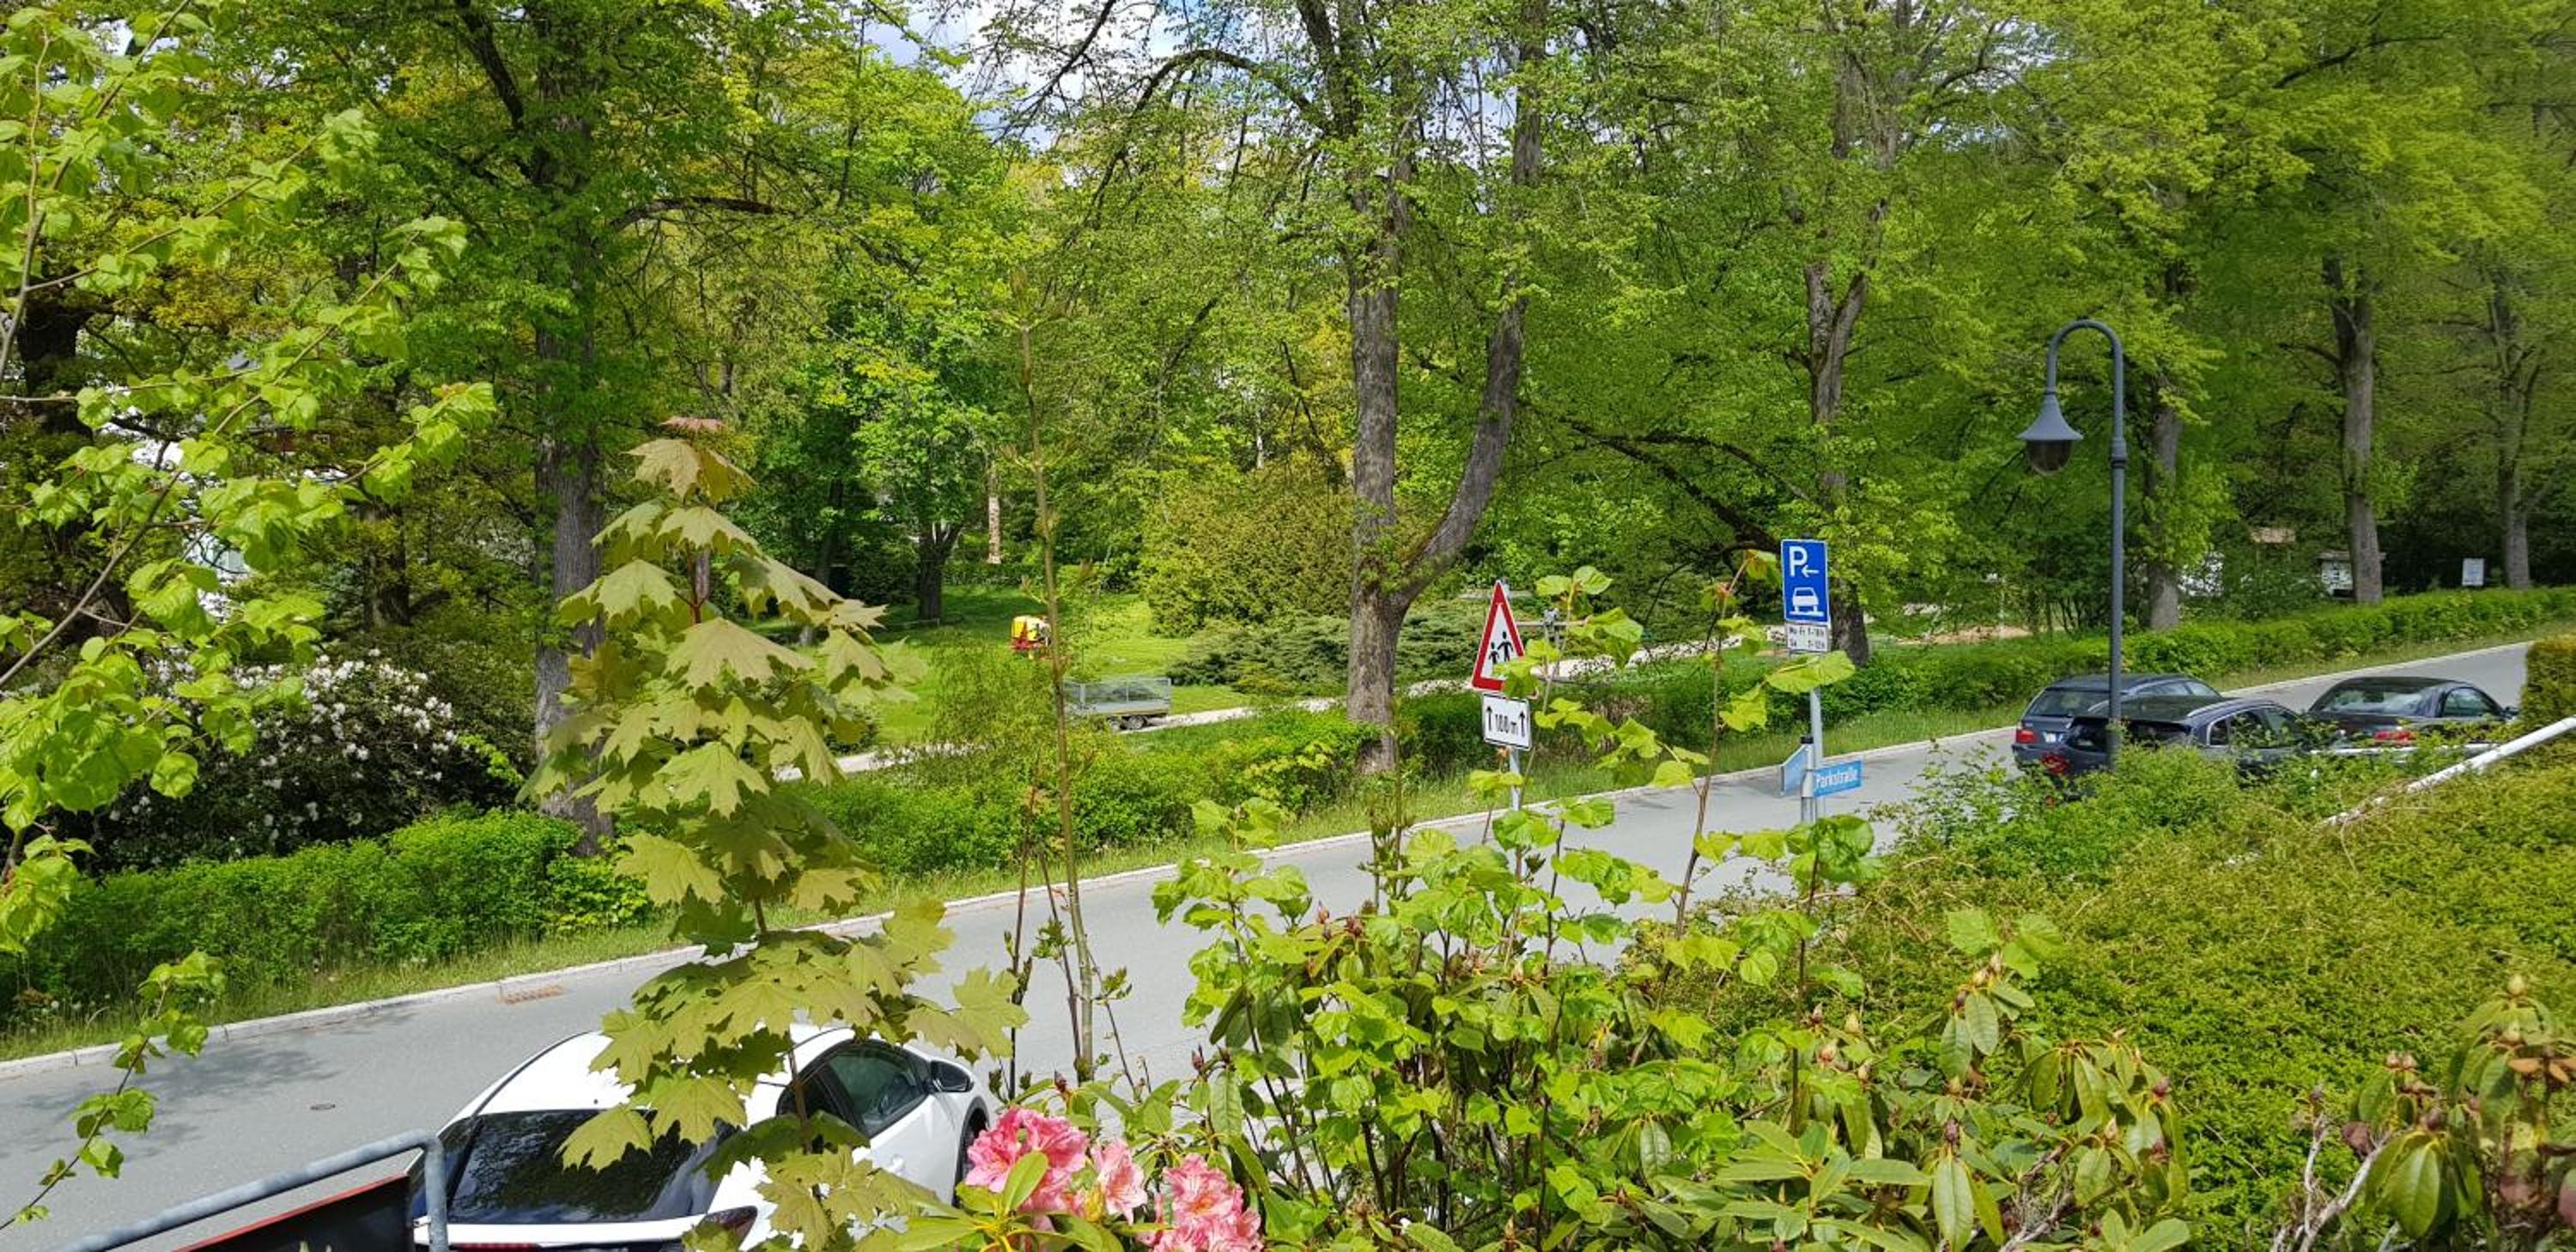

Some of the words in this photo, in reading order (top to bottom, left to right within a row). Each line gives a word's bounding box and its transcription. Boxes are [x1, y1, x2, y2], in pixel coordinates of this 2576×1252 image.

[1789, 545, 1807, 577] P
[1495, 714, 1510, 734] 100
[1814, 766, 1858, 788] Parkstraße
